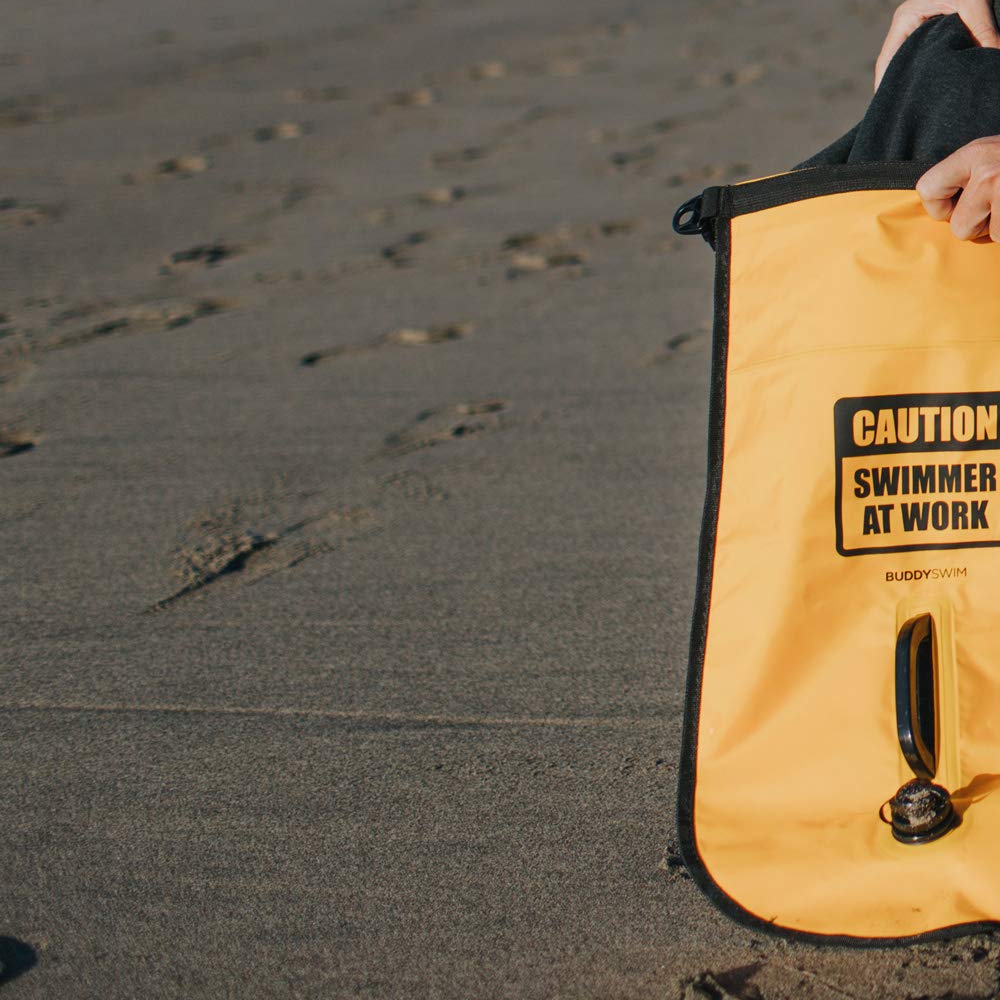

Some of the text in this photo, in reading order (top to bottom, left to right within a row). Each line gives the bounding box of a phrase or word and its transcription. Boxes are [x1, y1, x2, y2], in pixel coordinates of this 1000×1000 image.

[852, 405, 998, 447] CAUTION
[854, 463, 997, 498] SWIMMER
[863, 500, 989, 535] AT WORK
[885, 567, 967, 582] BUDDYSWIM
